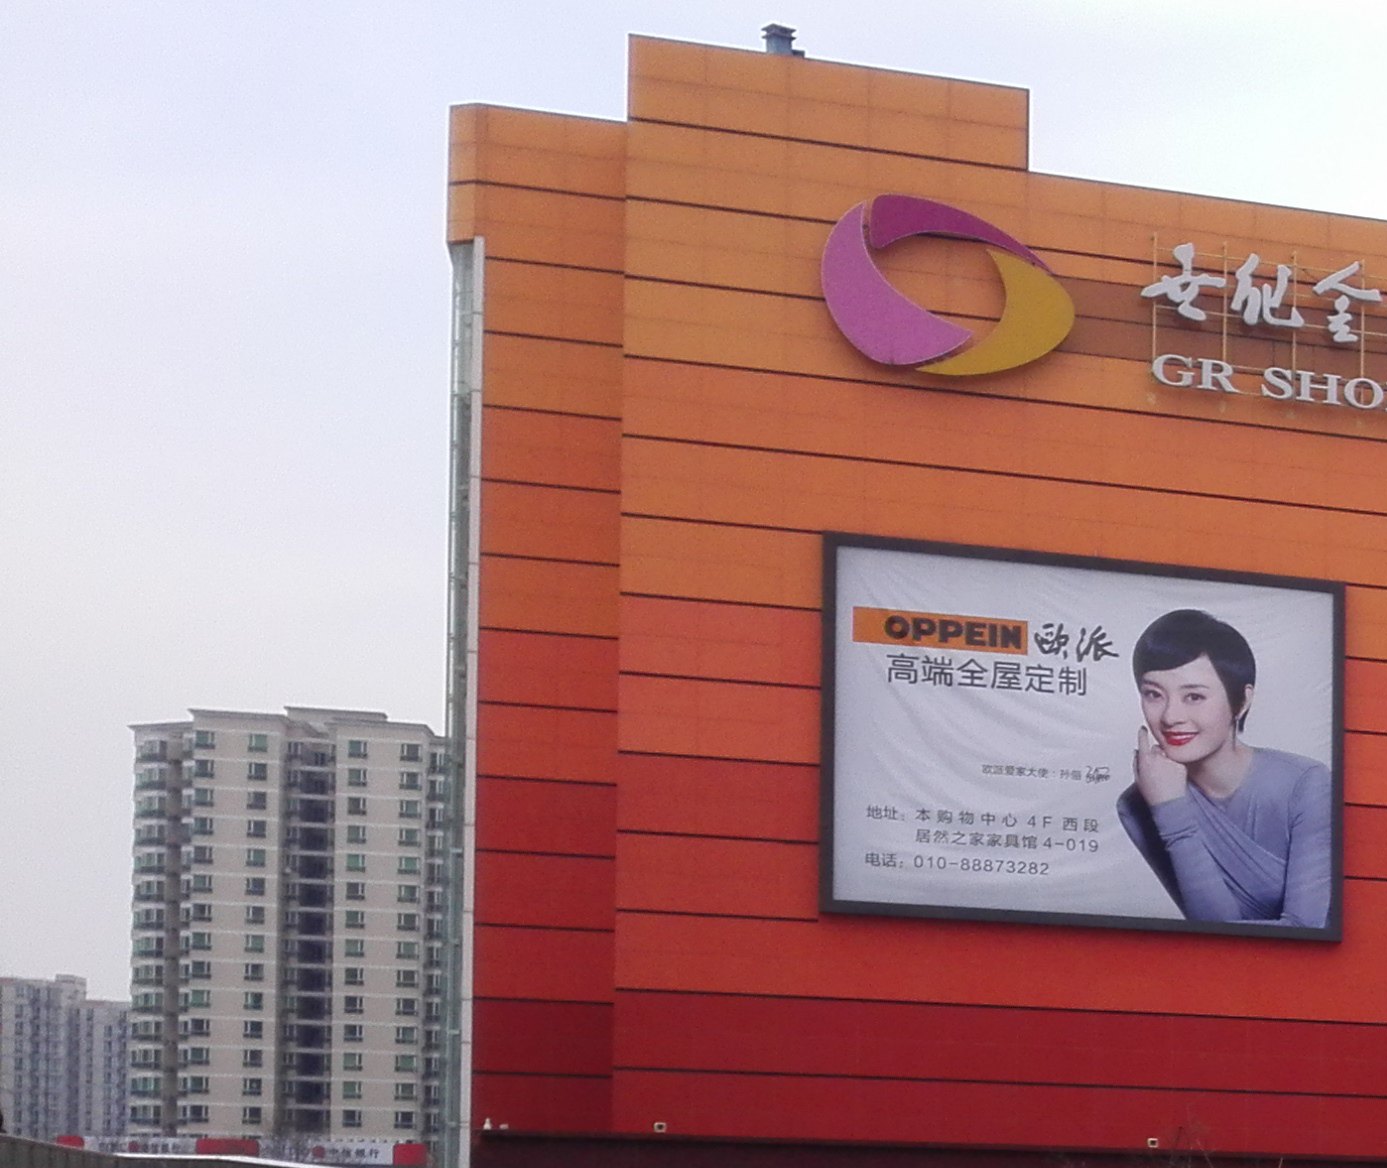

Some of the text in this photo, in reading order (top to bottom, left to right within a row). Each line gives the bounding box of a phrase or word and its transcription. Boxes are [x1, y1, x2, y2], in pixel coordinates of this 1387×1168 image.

[1151, 353, 1237, 392] GR
[884, 615, 1022, 650] OPPEIN
[886, 653, 1088, 697] 高端全屋定制
